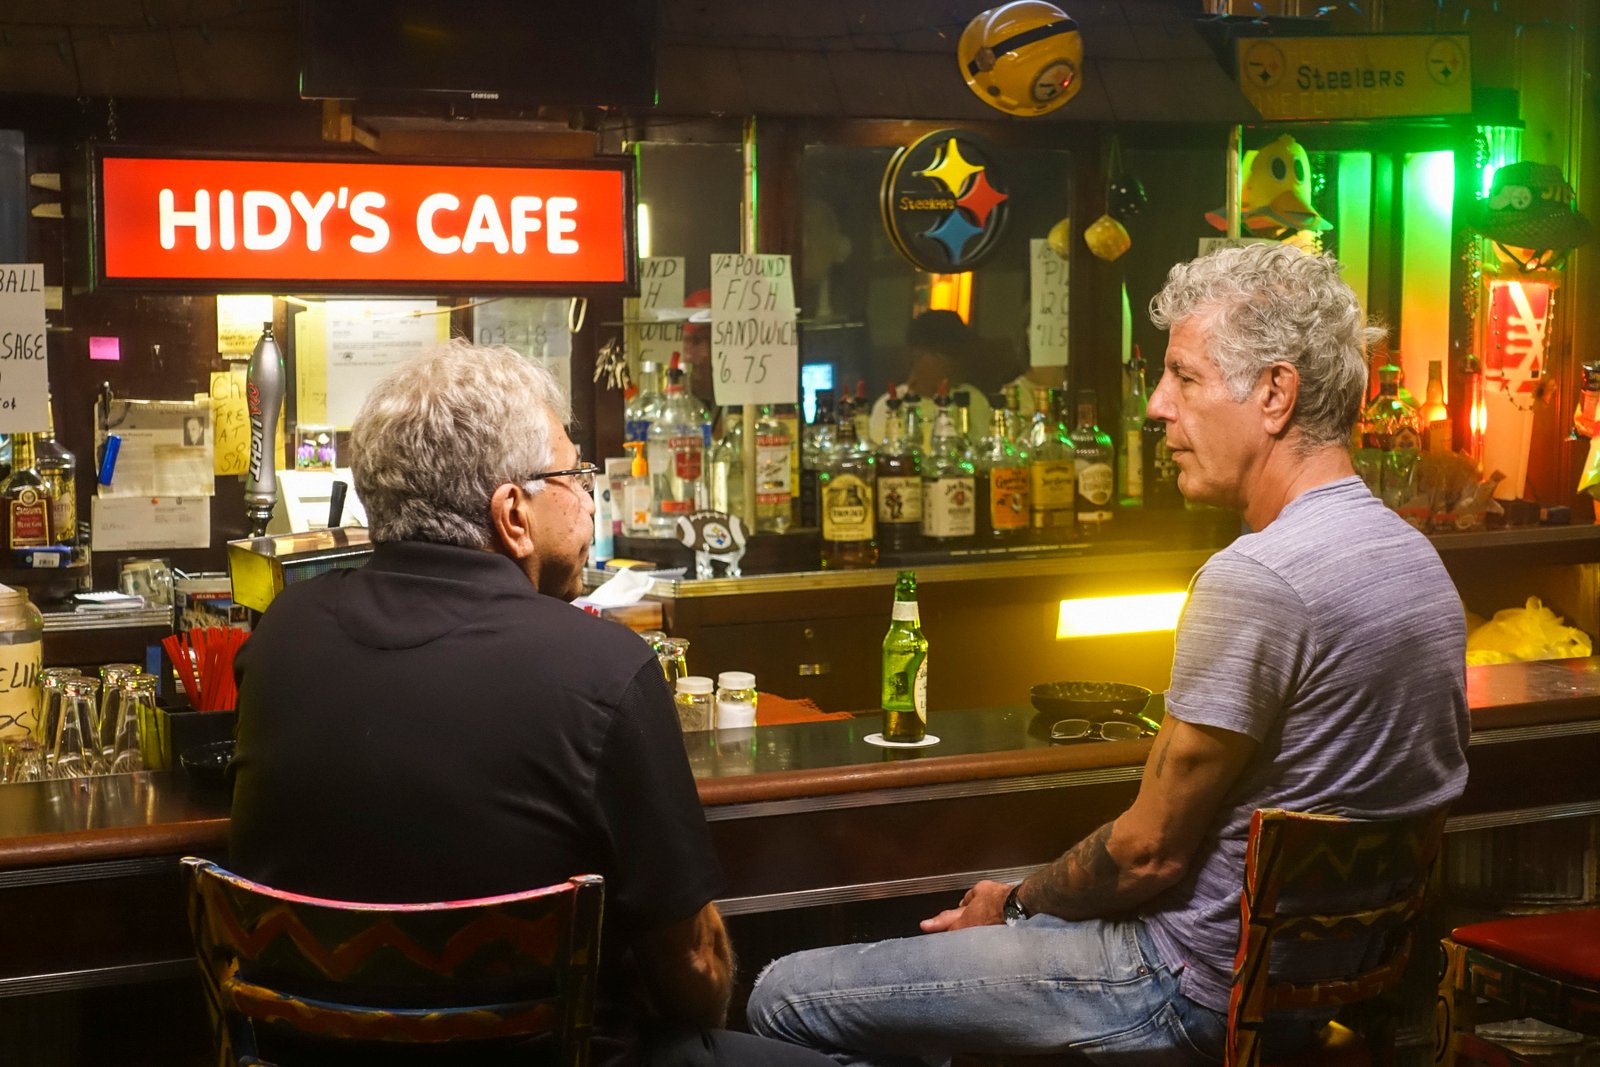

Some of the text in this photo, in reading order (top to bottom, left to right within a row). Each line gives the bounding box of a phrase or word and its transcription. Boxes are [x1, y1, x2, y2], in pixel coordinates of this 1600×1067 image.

[158, 187, 580, 255] HIDY'S CAFE
[734, 255, 786, 276] POUND
[723, 278, 779, 312] FISH
[250, 414, 263, 483] LIGHT
